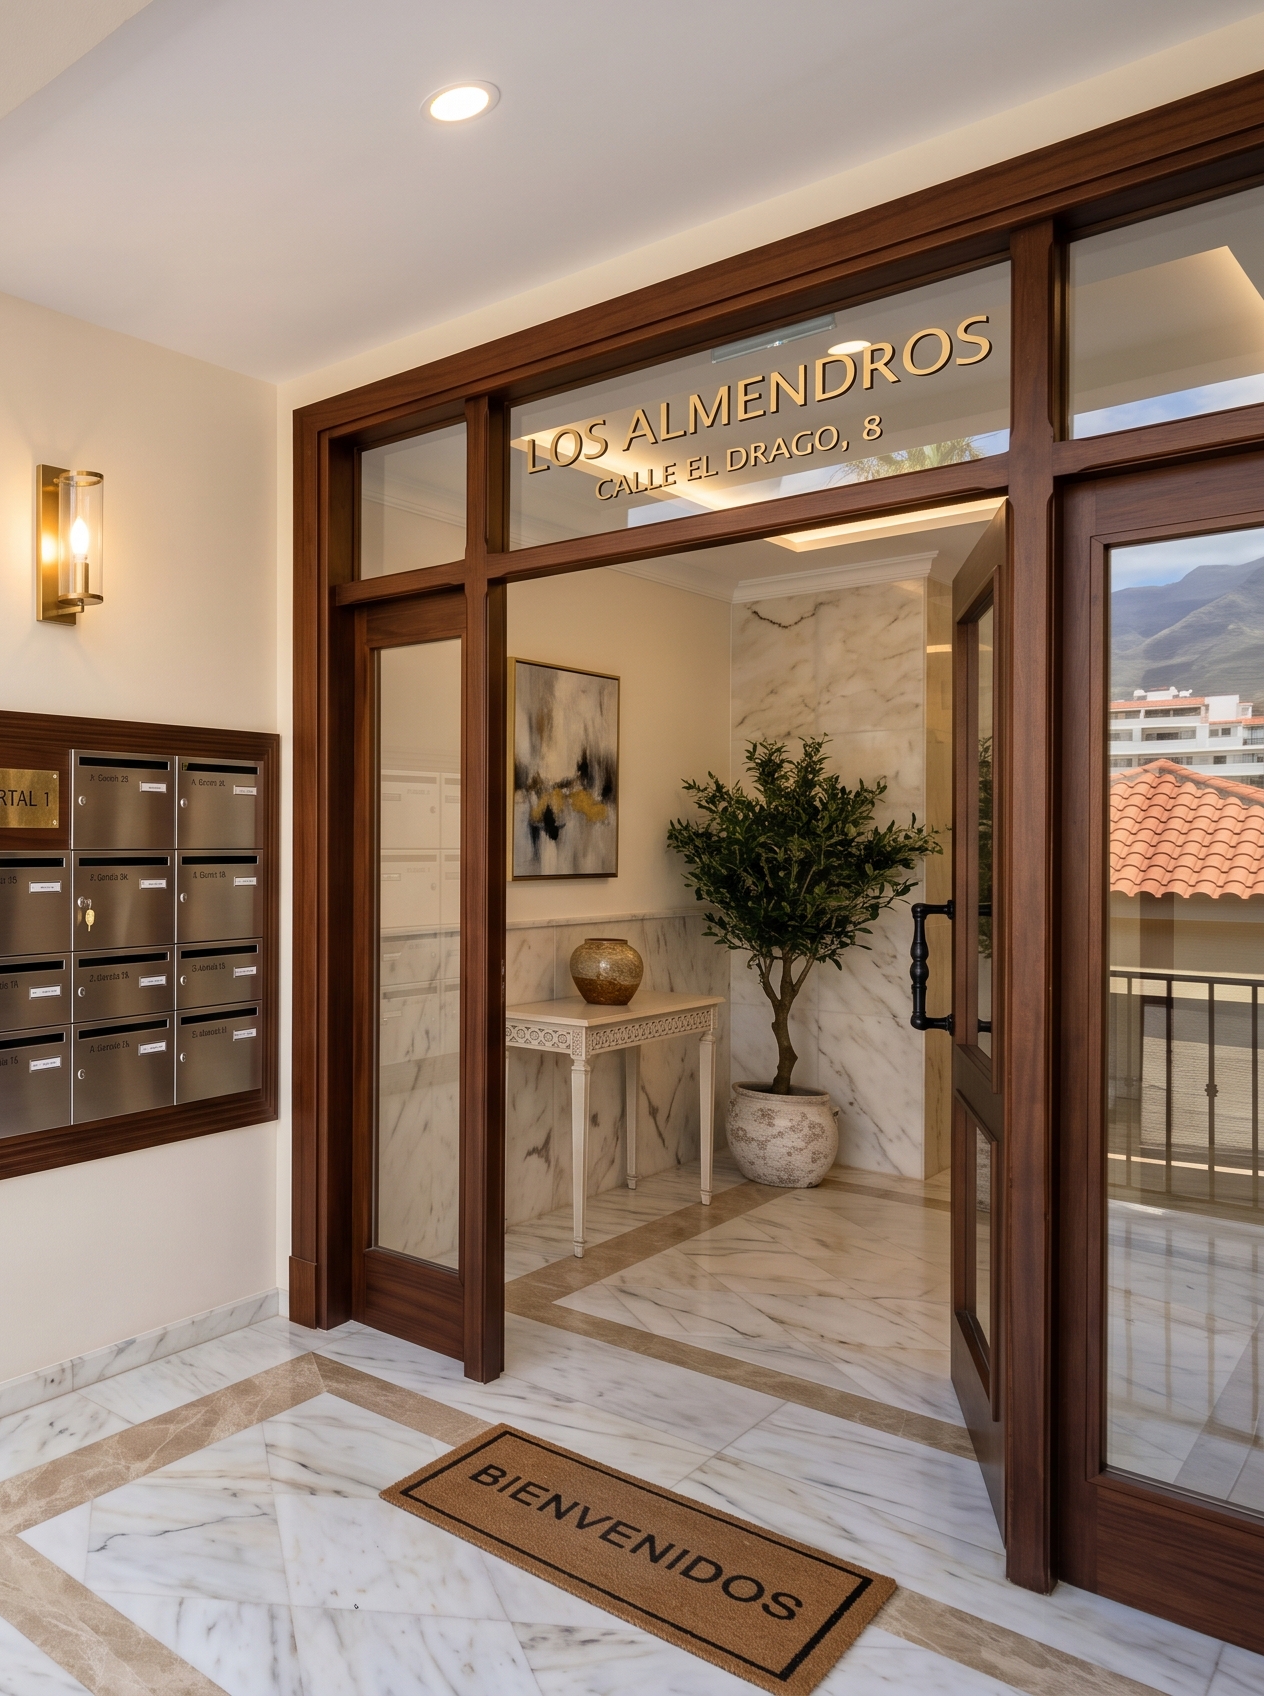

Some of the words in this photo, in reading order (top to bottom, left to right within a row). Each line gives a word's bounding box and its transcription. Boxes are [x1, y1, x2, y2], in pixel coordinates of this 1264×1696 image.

[527, 419, 609, 474] LOS
[622, 315, 993, 452] ALMENDROS
[595, 462, 677, 500] CALLE
[687, 455, 718, 481] EL
[726, 425, 849, 472] DRAGO,
[862, 415, 882, 441] 8
[44, 792, 49, 807] 1
[468, 1464, 804, 1621] BIENVENIDOS
